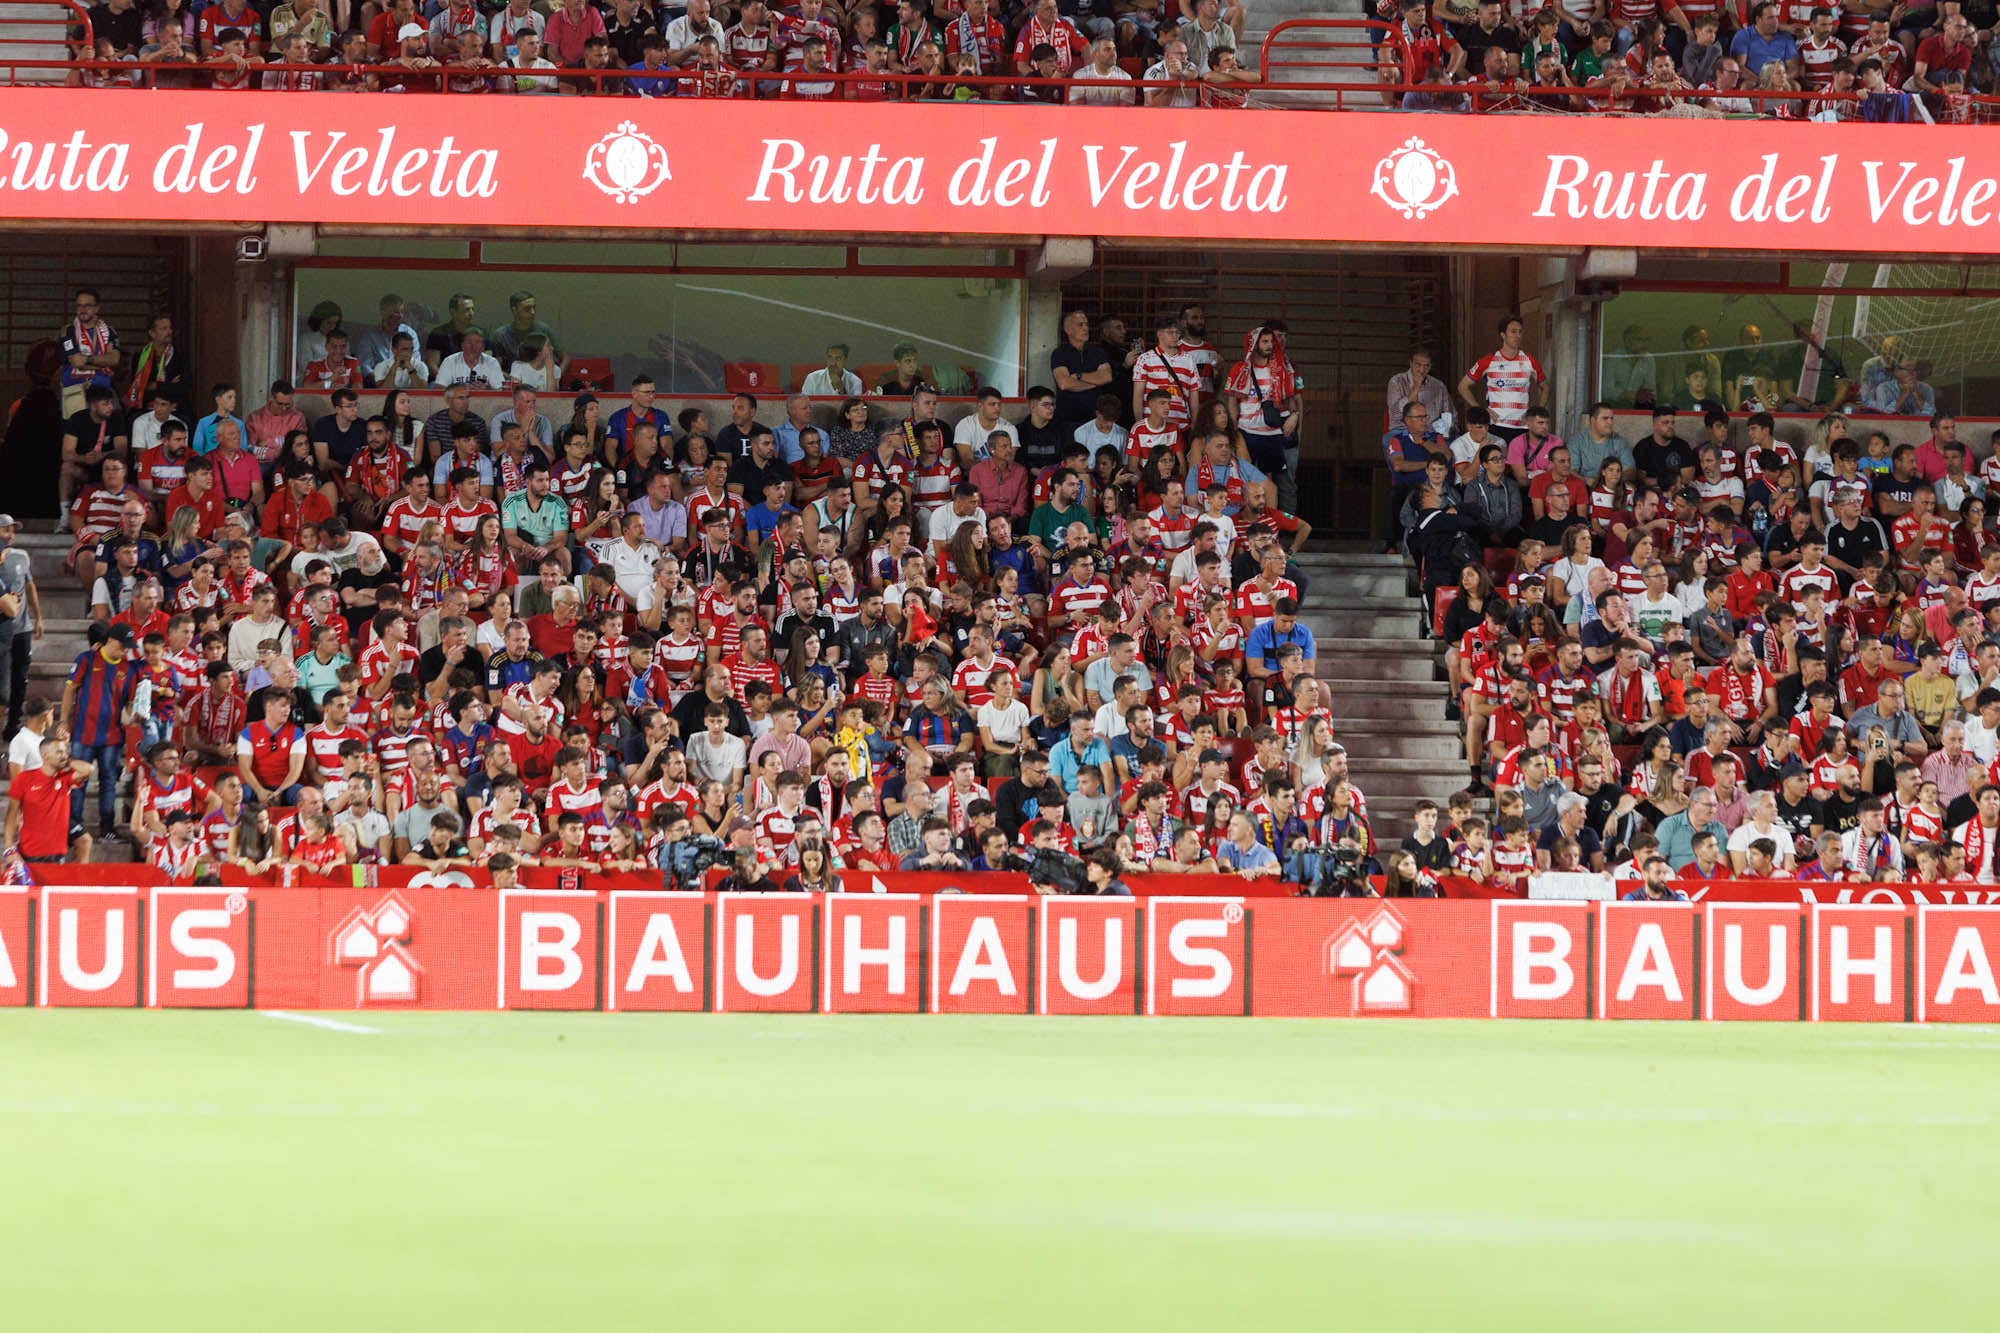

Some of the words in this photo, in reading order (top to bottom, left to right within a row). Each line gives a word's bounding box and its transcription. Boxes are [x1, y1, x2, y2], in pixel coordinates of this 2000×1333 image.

[0, 128, 130, 192] uta
[152, 122, 265, 194] del
[289, 125, 499, 198] Veleta
[746, 139, 925, 205] Ruta
[948, 136, 1058, 208] del
[1082, 140, 1288, 213] Veleta
[1532, 154, 1707, 221] Ruta
[1729, 152, 1838, 224] del
[1512, 921, 2000, 1006] BAUHA
